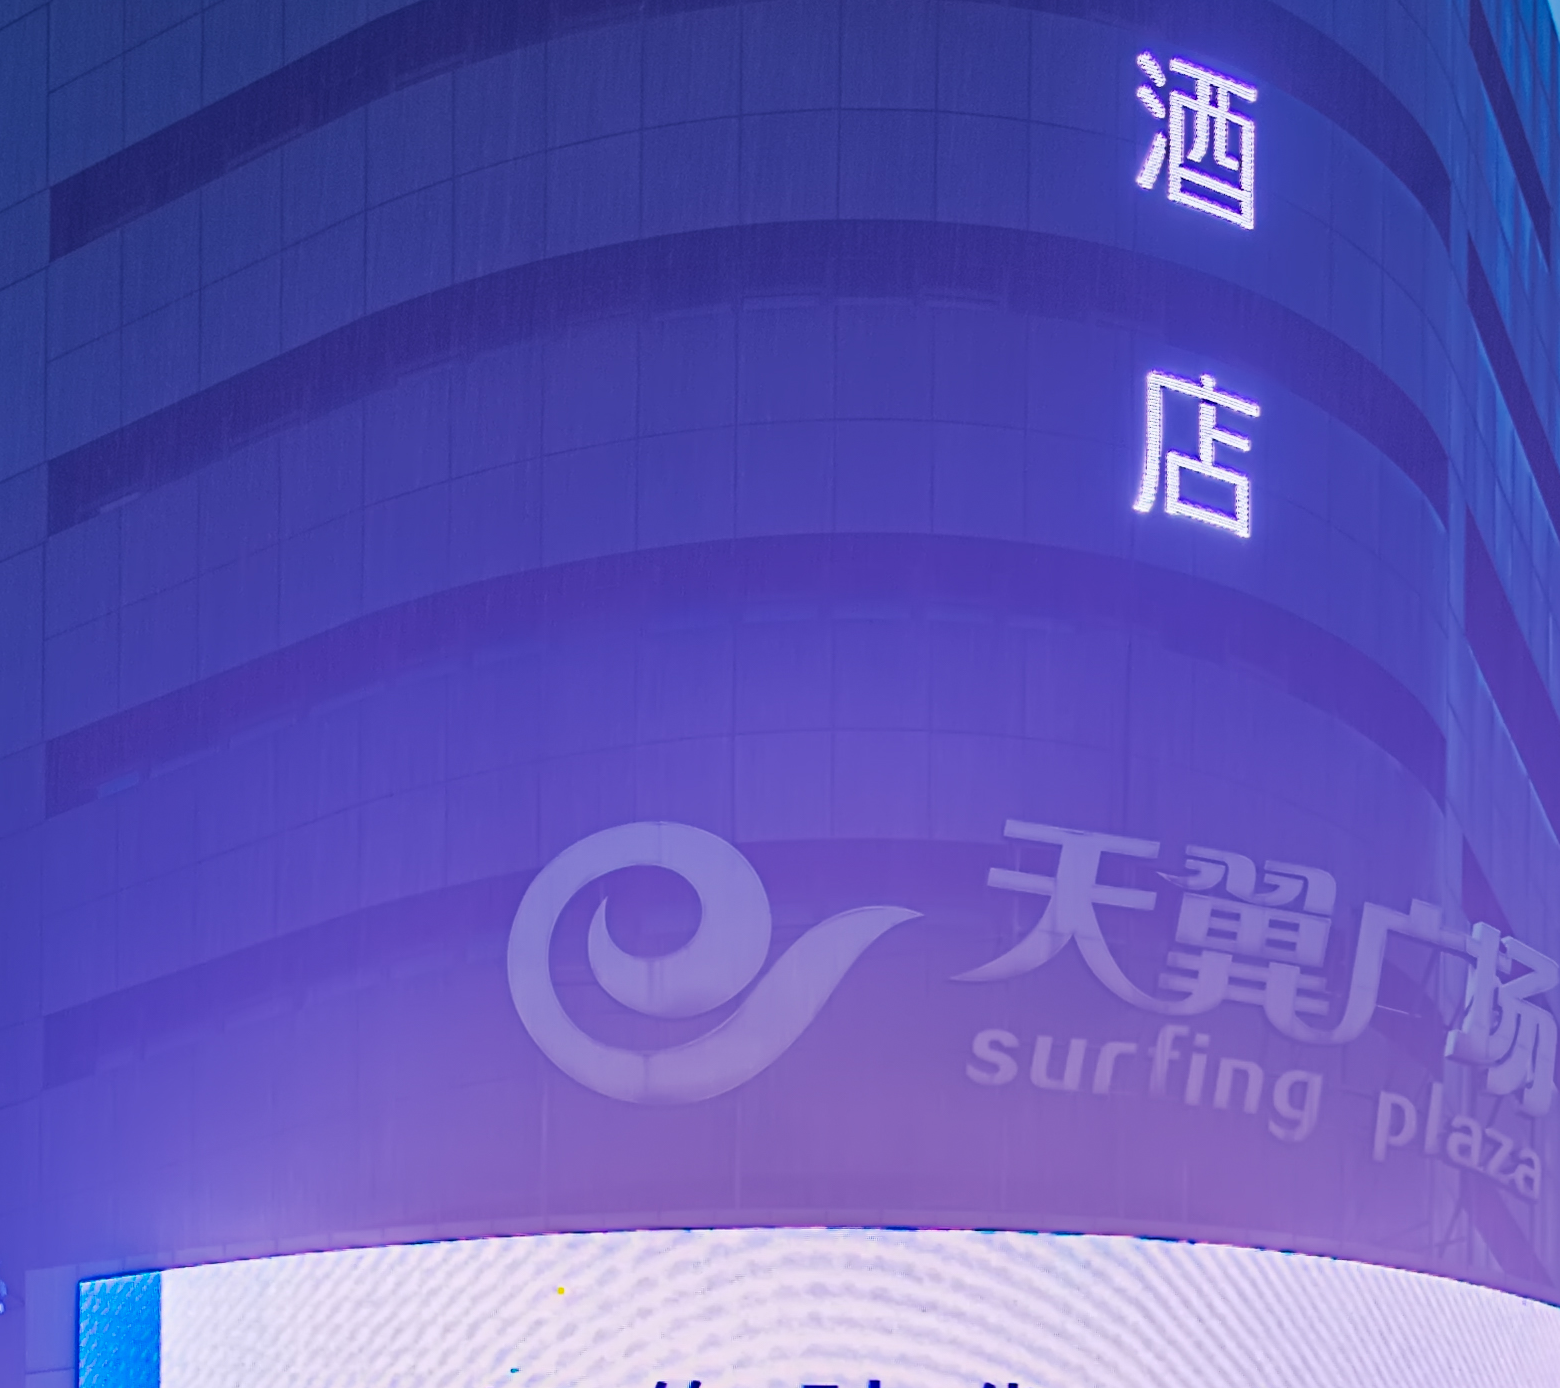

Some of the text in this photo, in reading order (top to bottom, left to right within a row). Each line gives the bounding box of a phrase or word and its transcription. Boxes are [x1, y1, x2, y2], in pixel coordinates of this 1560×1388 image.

[948, 817, 1560, 1118] 天翼广场
[964, 1021, 1545, 1201] surfing plaza
